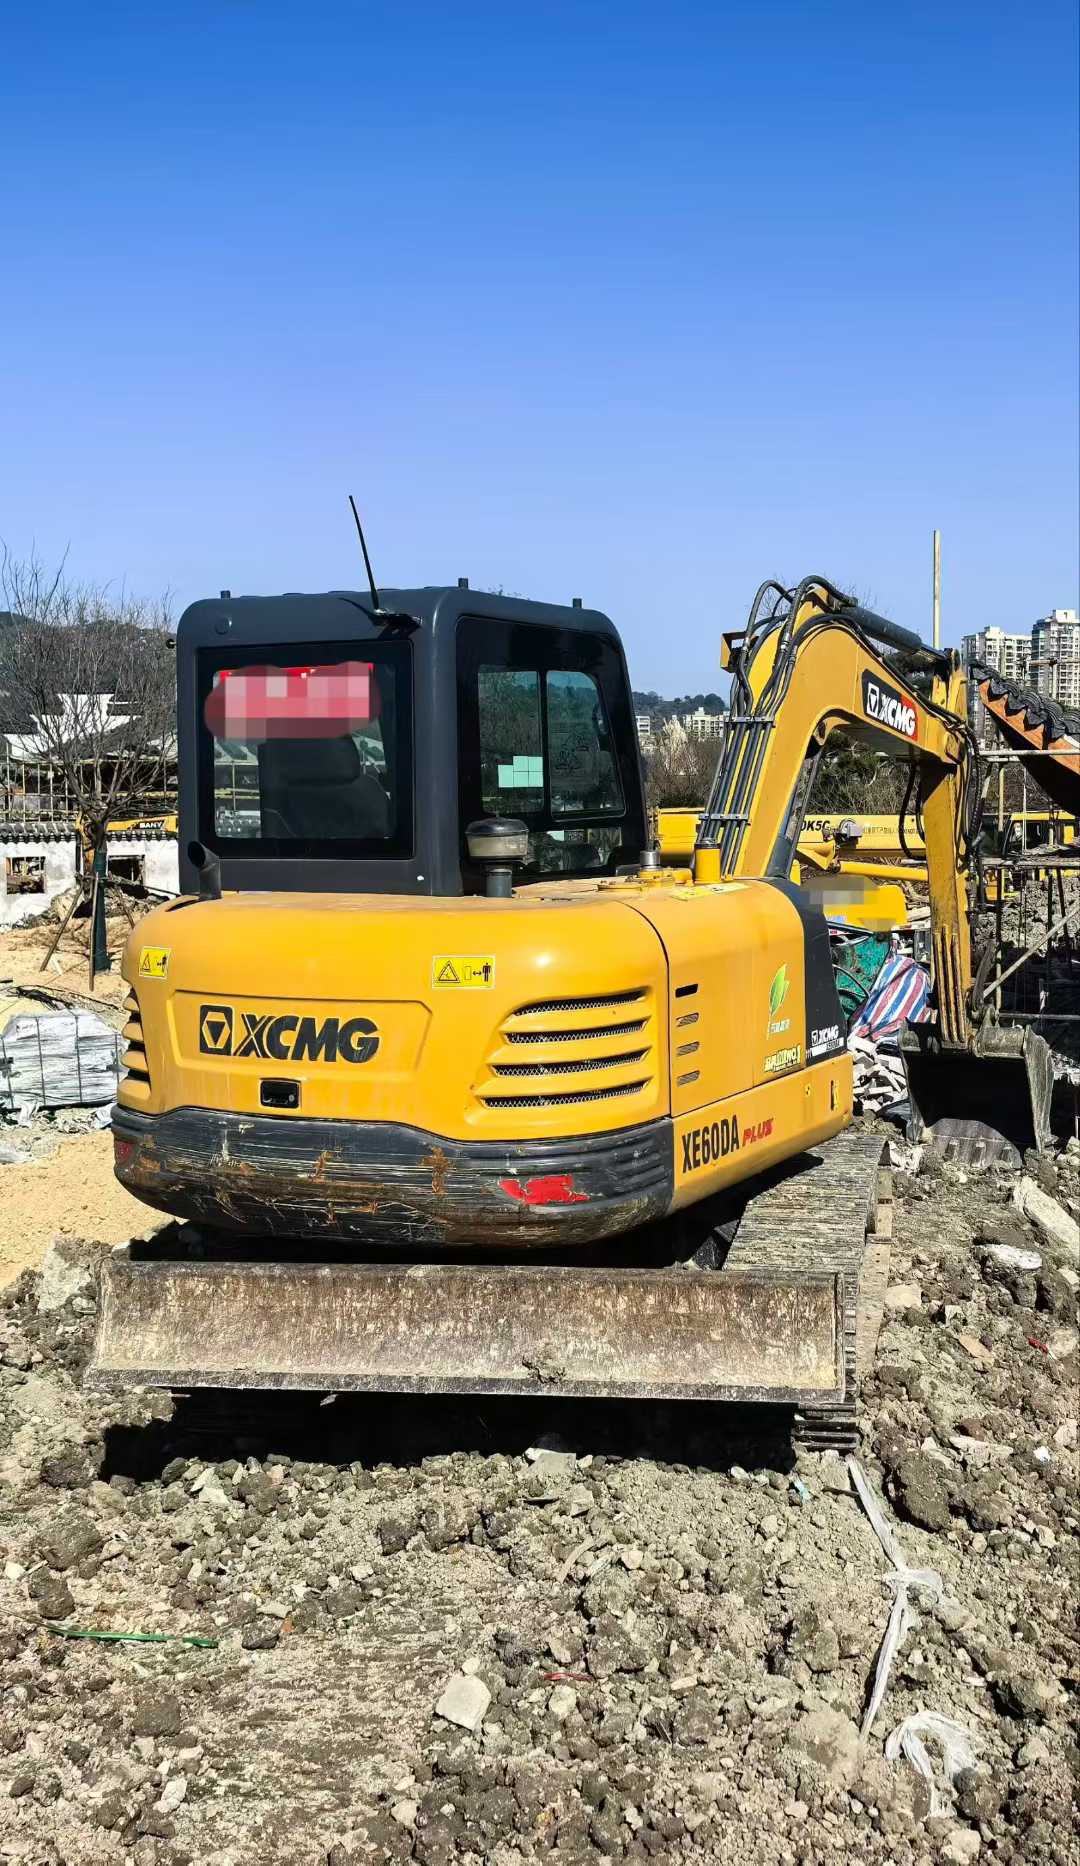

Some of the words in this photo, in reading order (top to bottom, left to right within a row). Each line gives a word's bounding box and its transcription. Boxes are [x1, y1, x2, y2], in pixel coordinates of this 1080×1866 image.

[879, 692, 916, 736] XCMG
[233, 1013, 380, 1064] XCMG
[682, 1114, 740, 1174] XE60DA
[742, 1117, 774, 1147] PLUS
